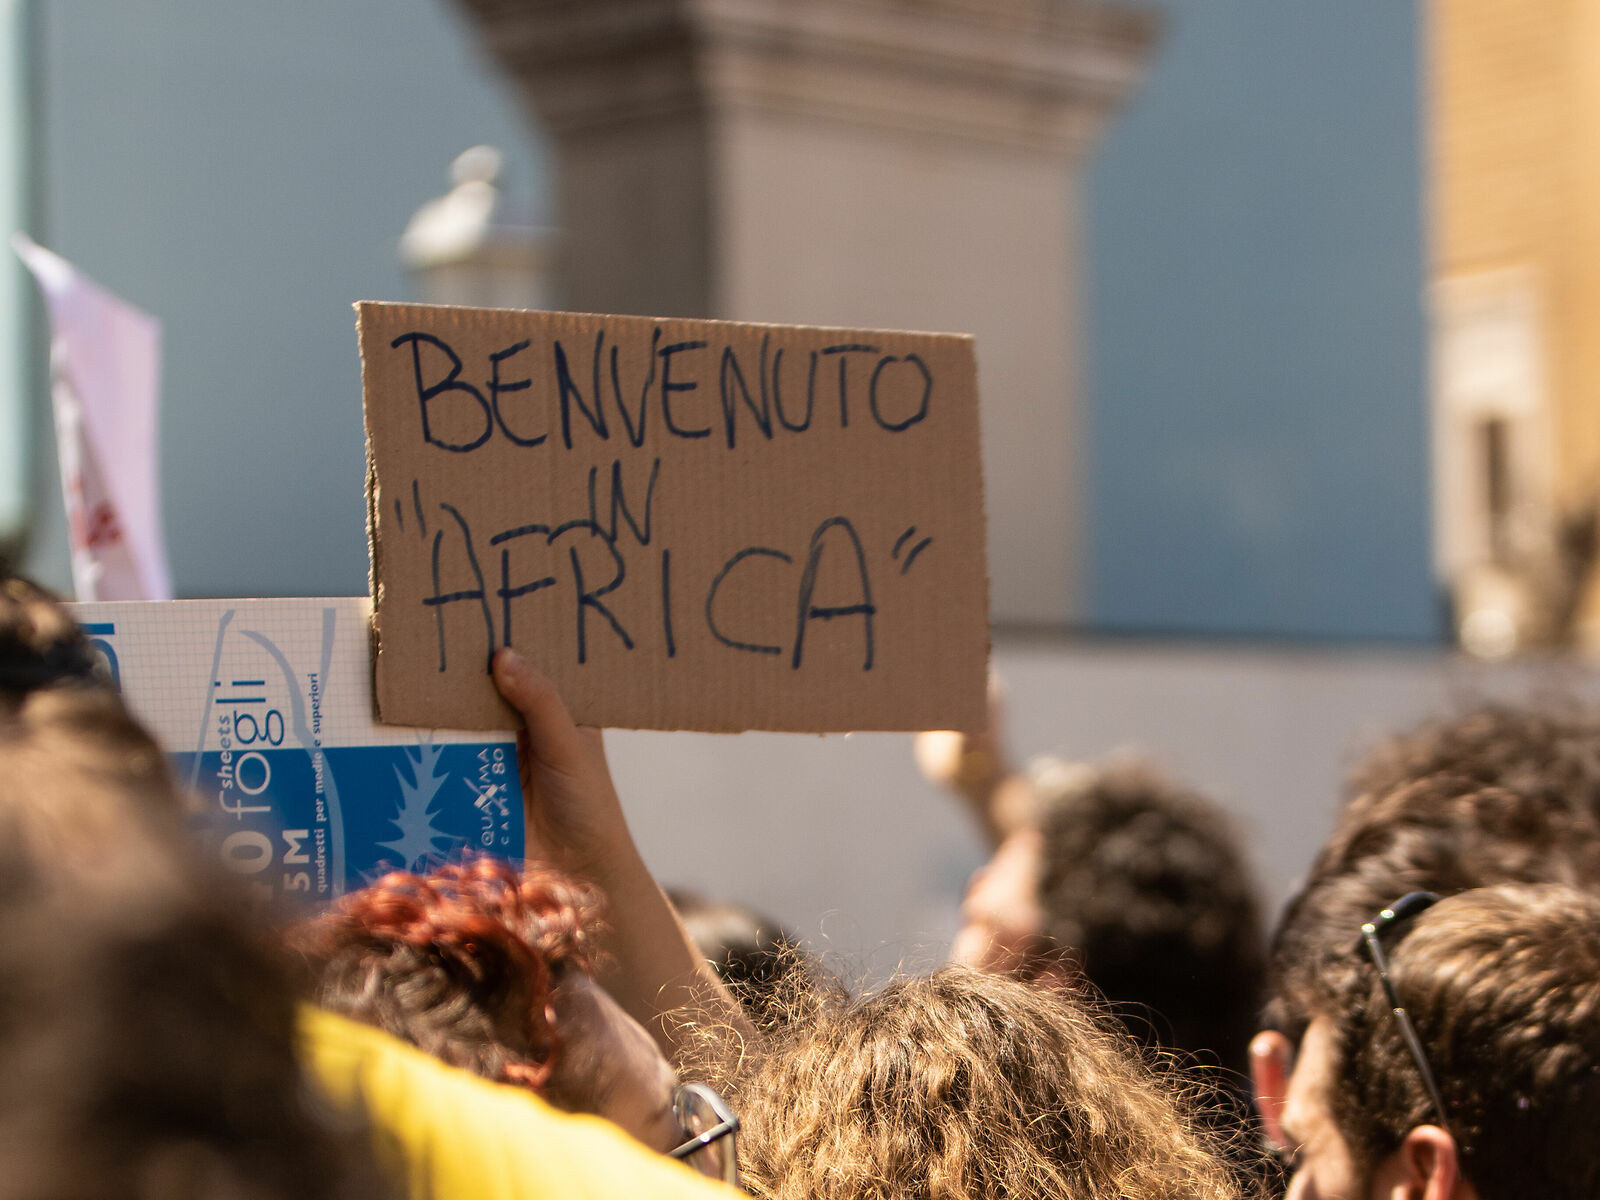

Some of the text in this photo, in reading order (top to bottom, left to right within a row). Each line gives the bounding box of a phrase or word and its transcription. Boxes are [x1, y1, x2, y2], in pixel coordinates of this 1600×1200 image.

[392, 327, 932, 453] BENVENUTO
[588, 457, 661, 546] IN
[212, 679, 285, 821] fogli
[216, 714, 234, 790] sheets
[307, 672, 329, 893] quadretti per medie e superiori
[491, 747, 506, 776] 80
